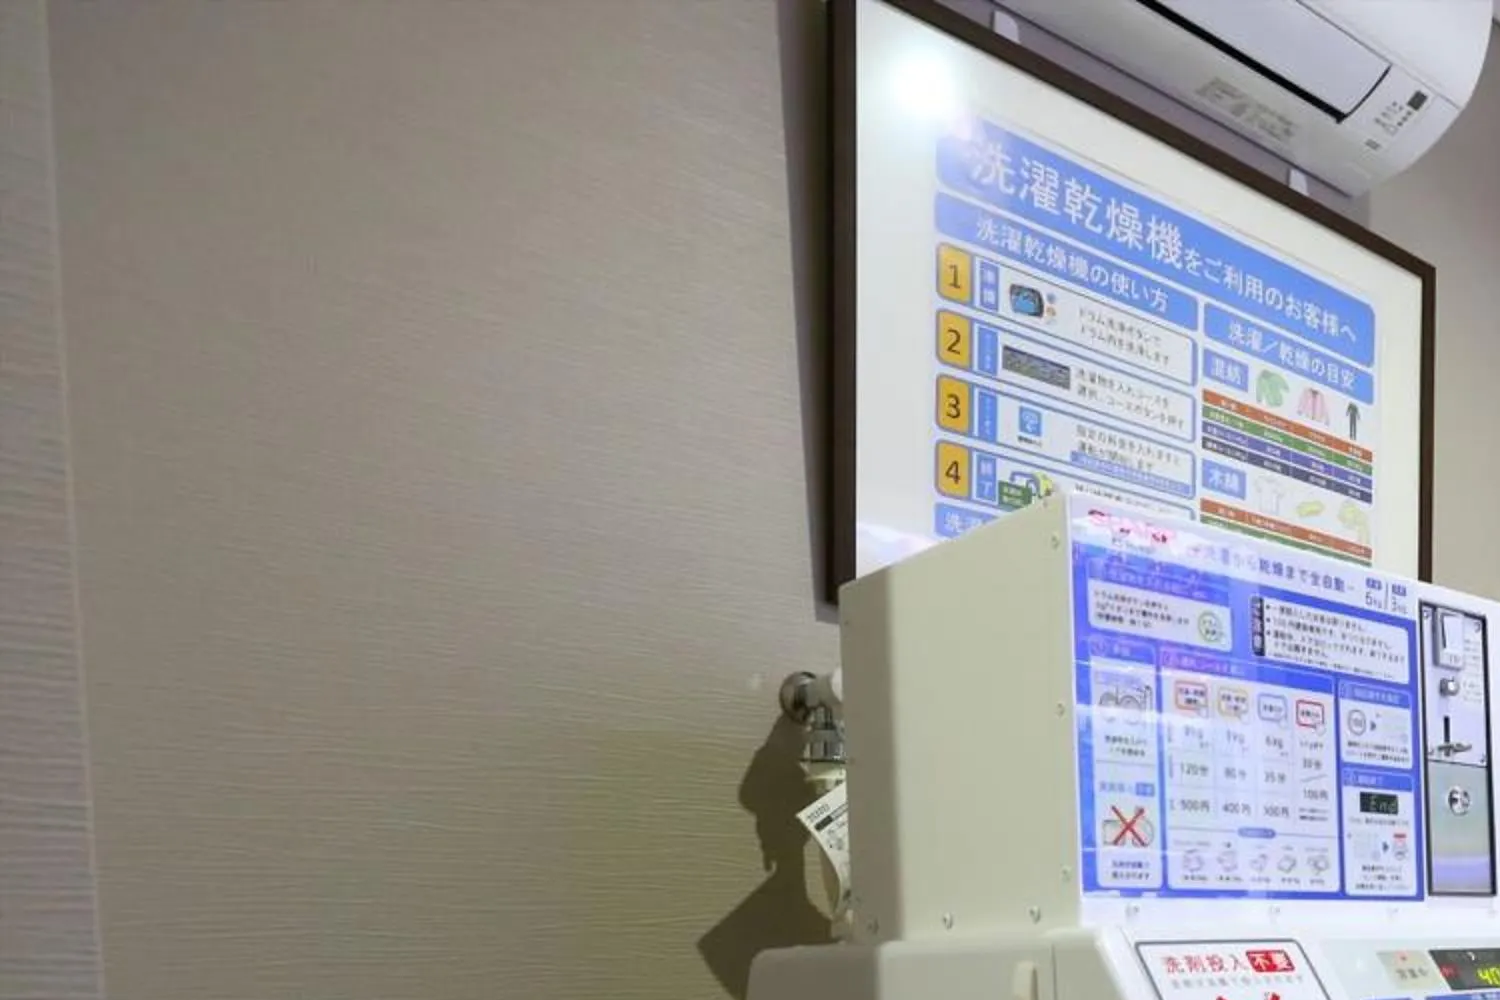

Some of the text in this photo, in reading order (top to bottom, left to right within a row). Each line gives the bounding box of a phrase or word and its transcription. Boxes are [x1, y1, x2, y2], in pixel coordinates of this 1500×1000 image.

[968, 142, 1357, 343] 洗濯乾燥機をご利用のお客様へ
[949, 264, 961, 290] 1
[976, 218, 1169, 313] 洗濯乾燥機の使い方
[946, 329, 961, 355] 2
[945, 393, 961, 419] 3
[944, 460, 961, 485] 4
